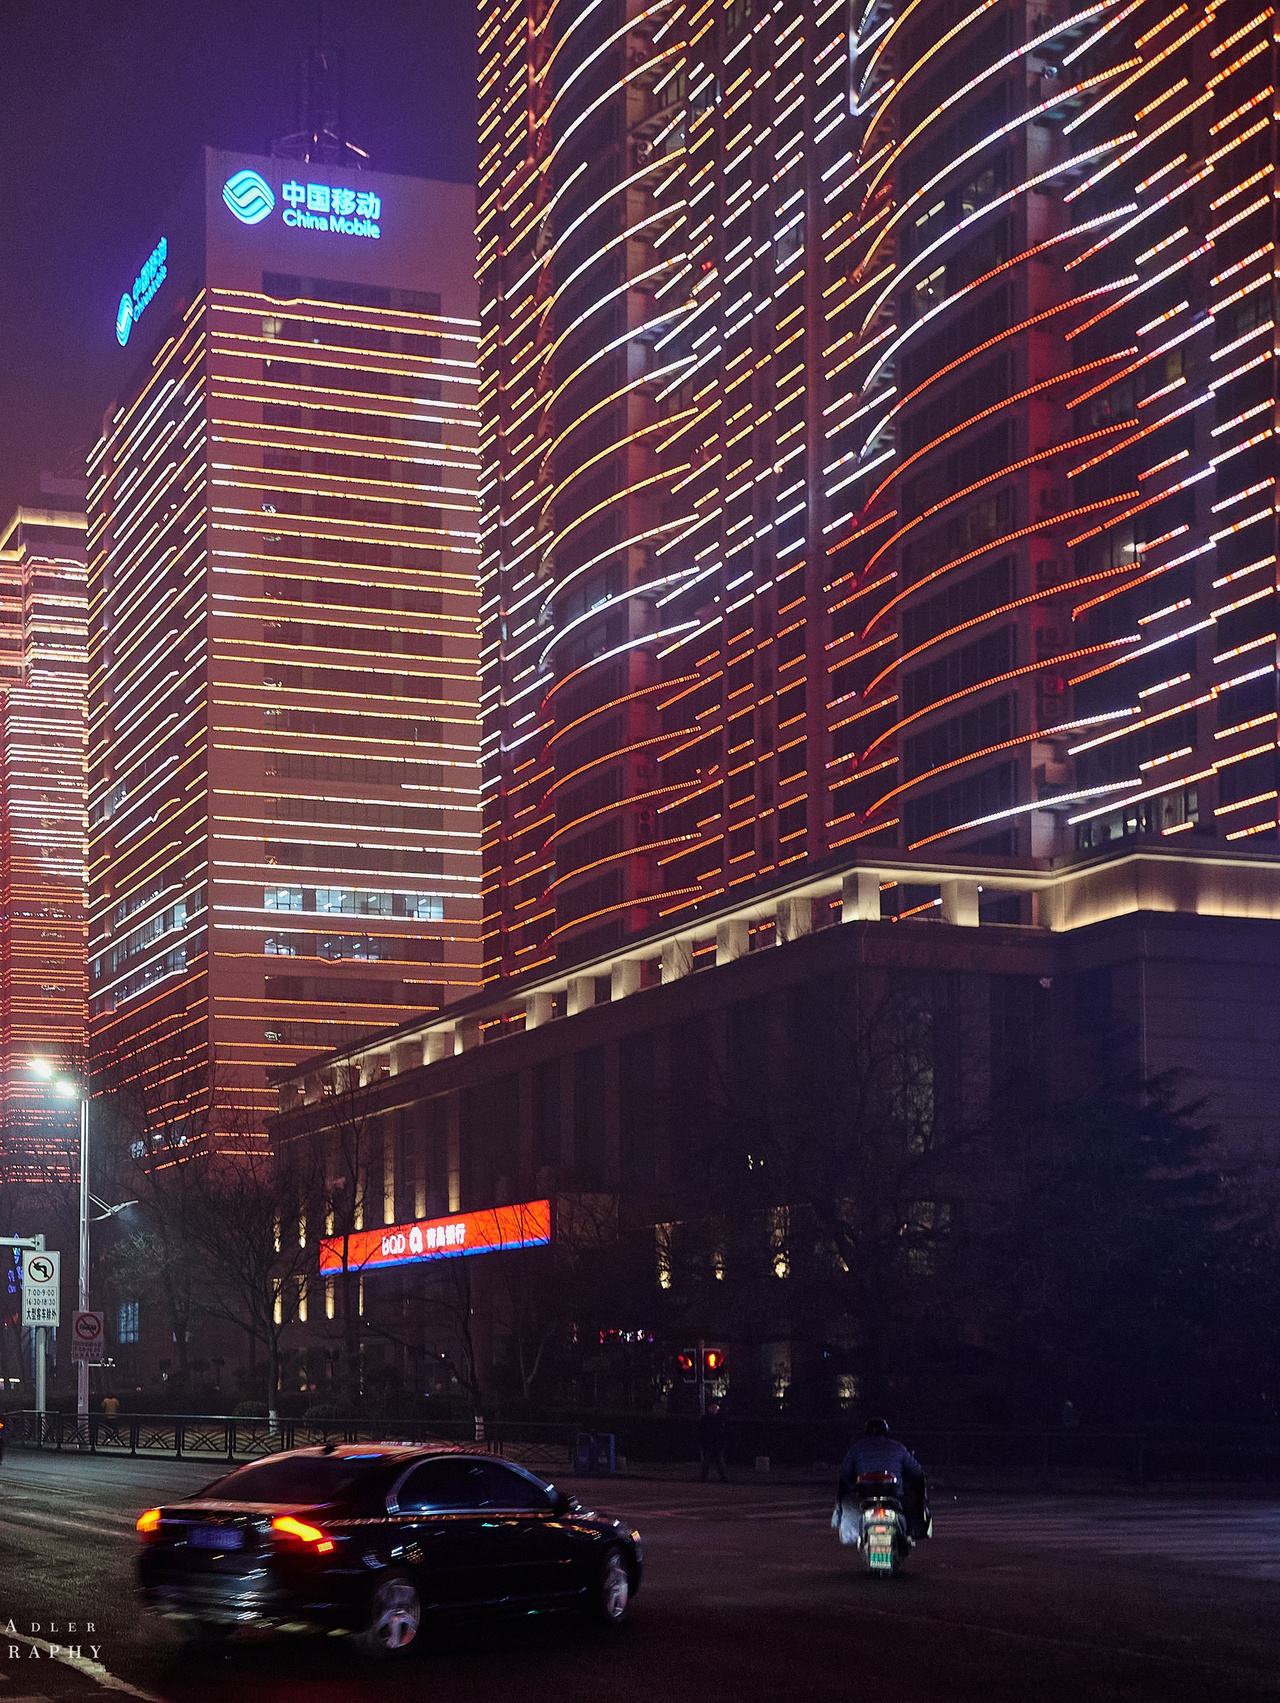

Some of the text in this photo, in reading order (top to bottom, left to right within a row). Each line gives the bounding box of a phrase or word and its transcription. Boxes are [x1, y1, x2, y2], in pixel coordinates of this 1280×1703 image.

[281, 179, 382, 220] 中国移动
[282, 208, 381, 239] China Mobile
[381, 1233, 406, 1256] BQD
[26, 1307, 57, 1321] 大型客车除外
